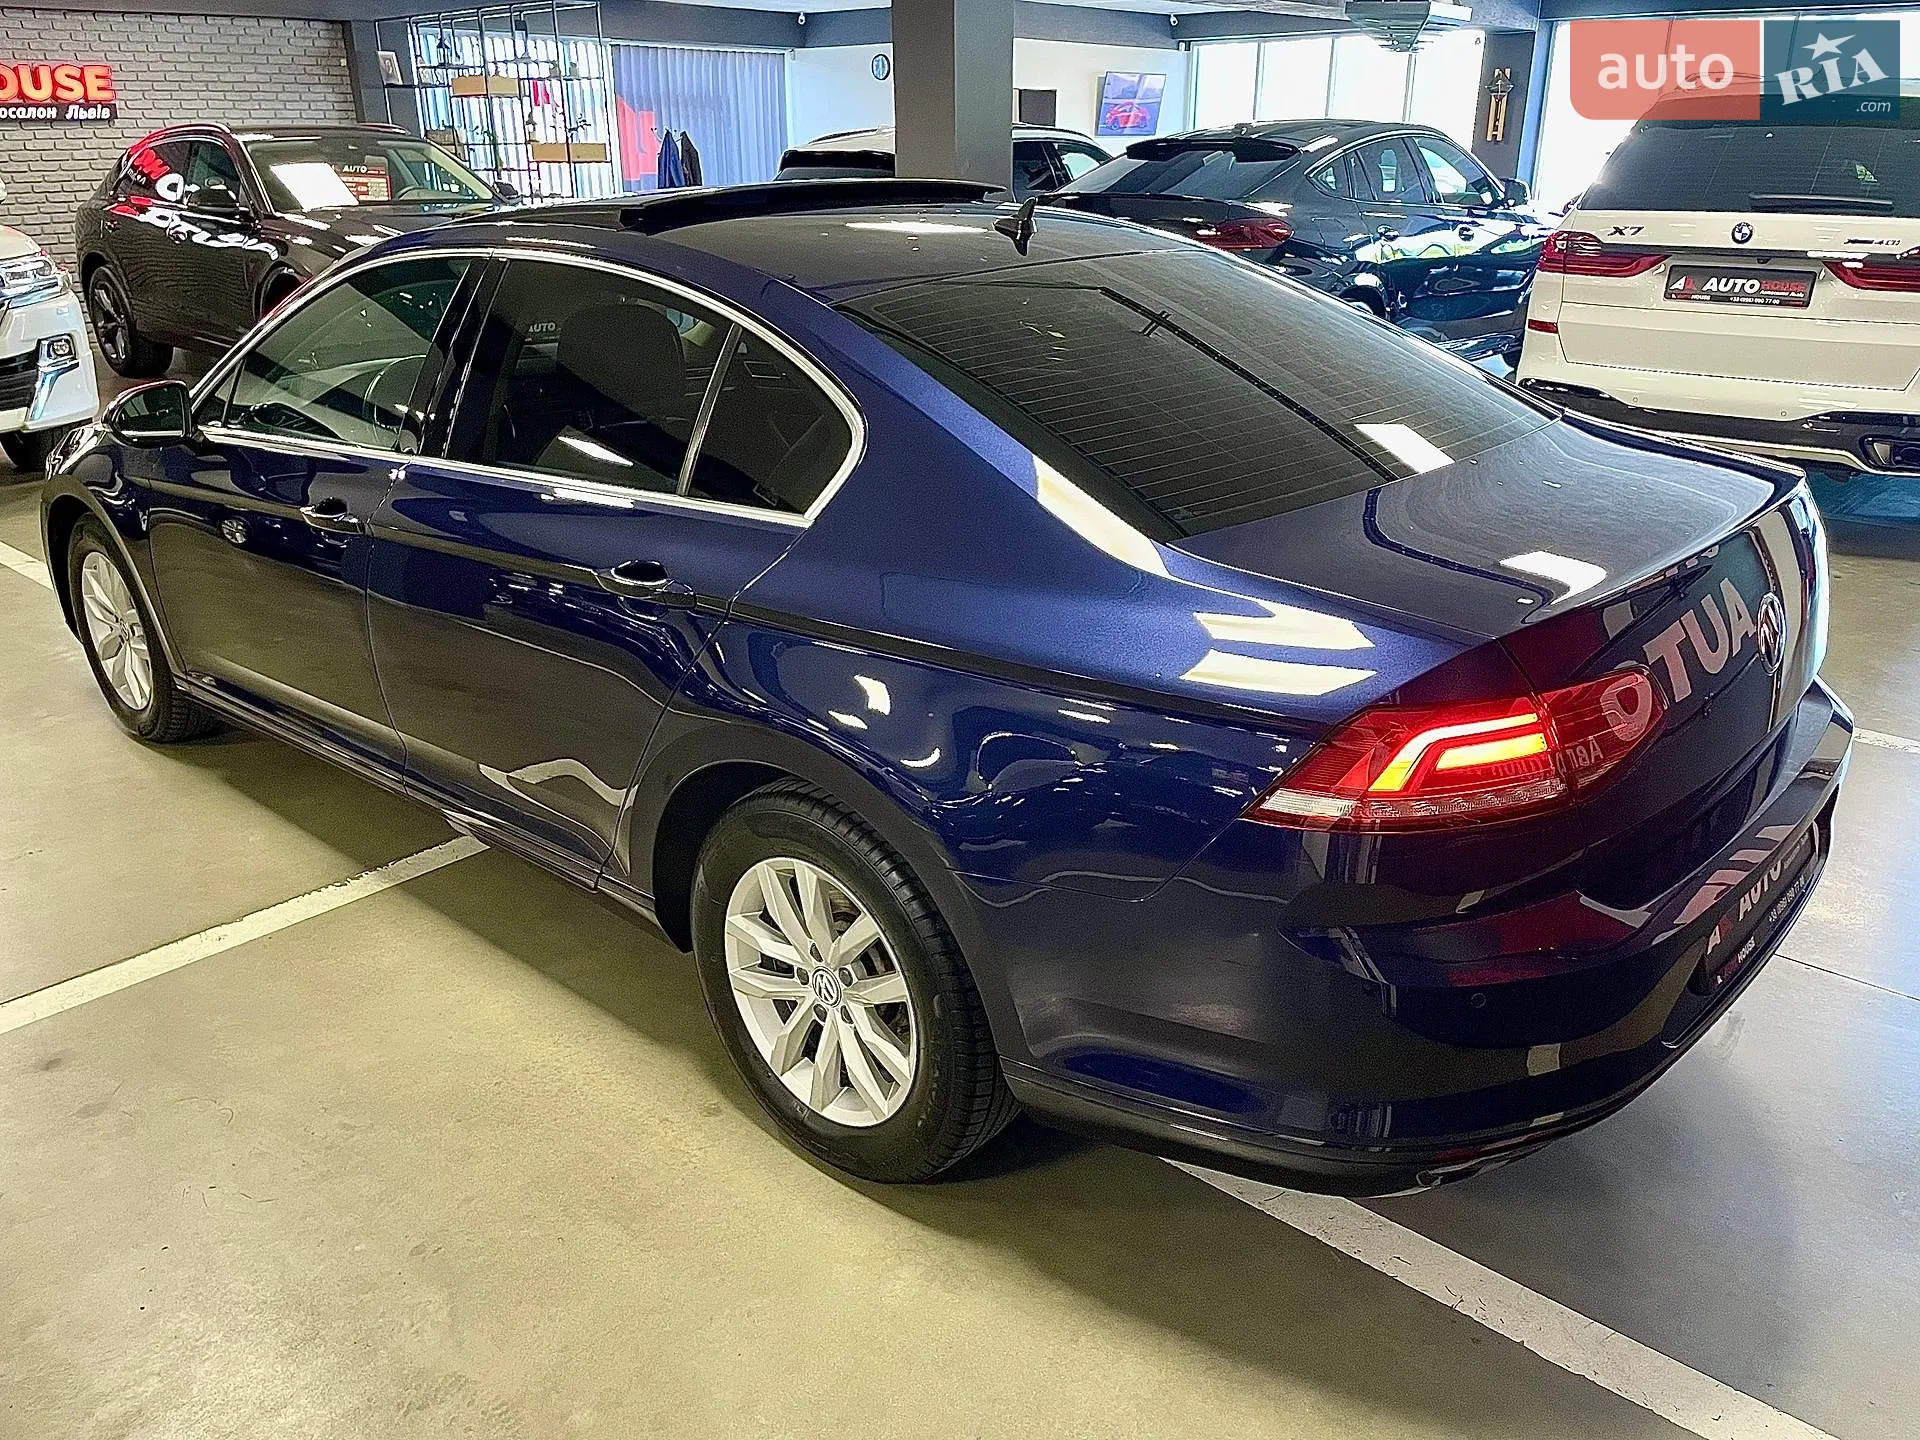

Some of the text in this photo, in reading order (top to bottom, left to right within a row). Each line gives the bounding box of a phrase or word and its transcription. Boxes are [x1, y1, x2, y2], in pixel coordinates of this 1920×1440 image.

[65, 104, 111, 120] Львів
[342, 164, 368, 174] AUTO
[1607, 226, 1645, 236] X7
[1701, 277, 1760, 294] AUTO
